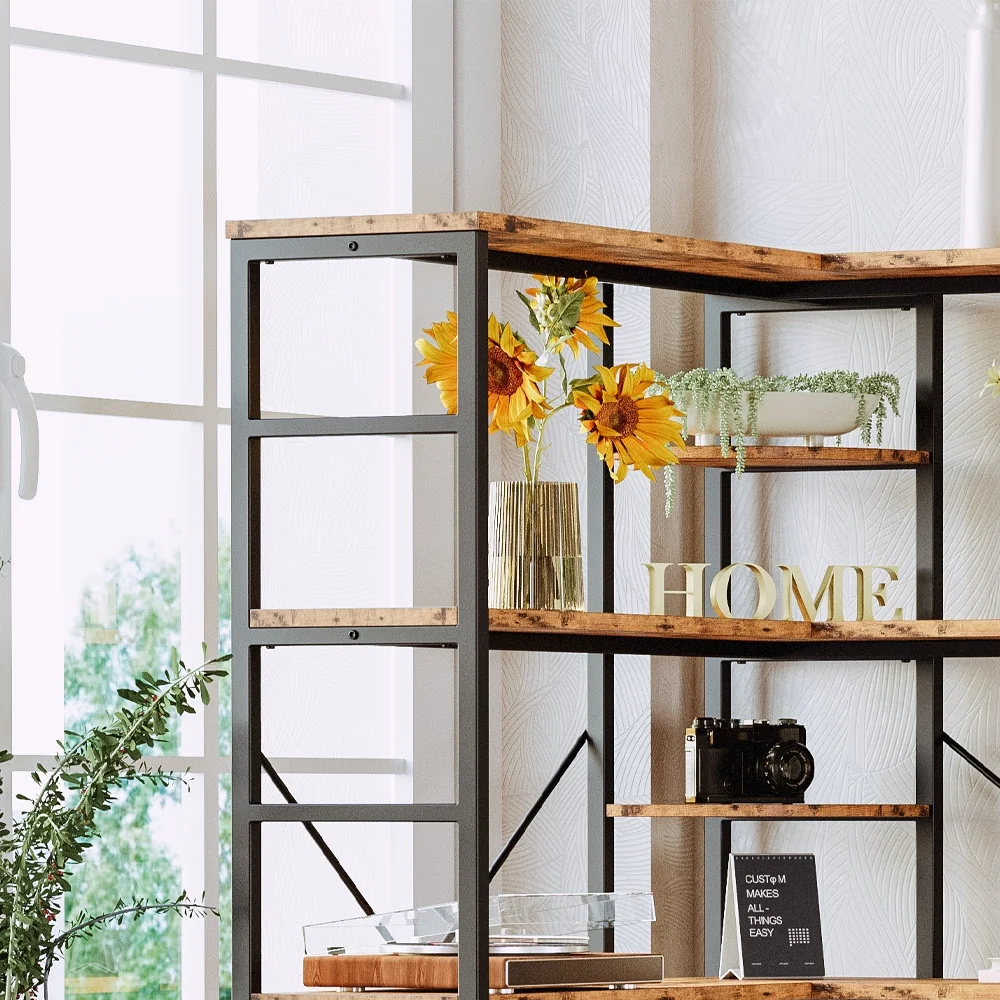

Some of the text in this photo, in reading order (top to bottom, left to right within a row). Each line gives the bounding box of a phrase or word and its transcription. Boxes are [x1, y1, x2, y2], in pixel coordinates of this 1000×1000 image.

[641, 562, 903, 622] HOME
[746, 889, 780, 898] MAKES
[748, 916, 782, 925] THINGS
[750, 928, 774, 938] EASY
